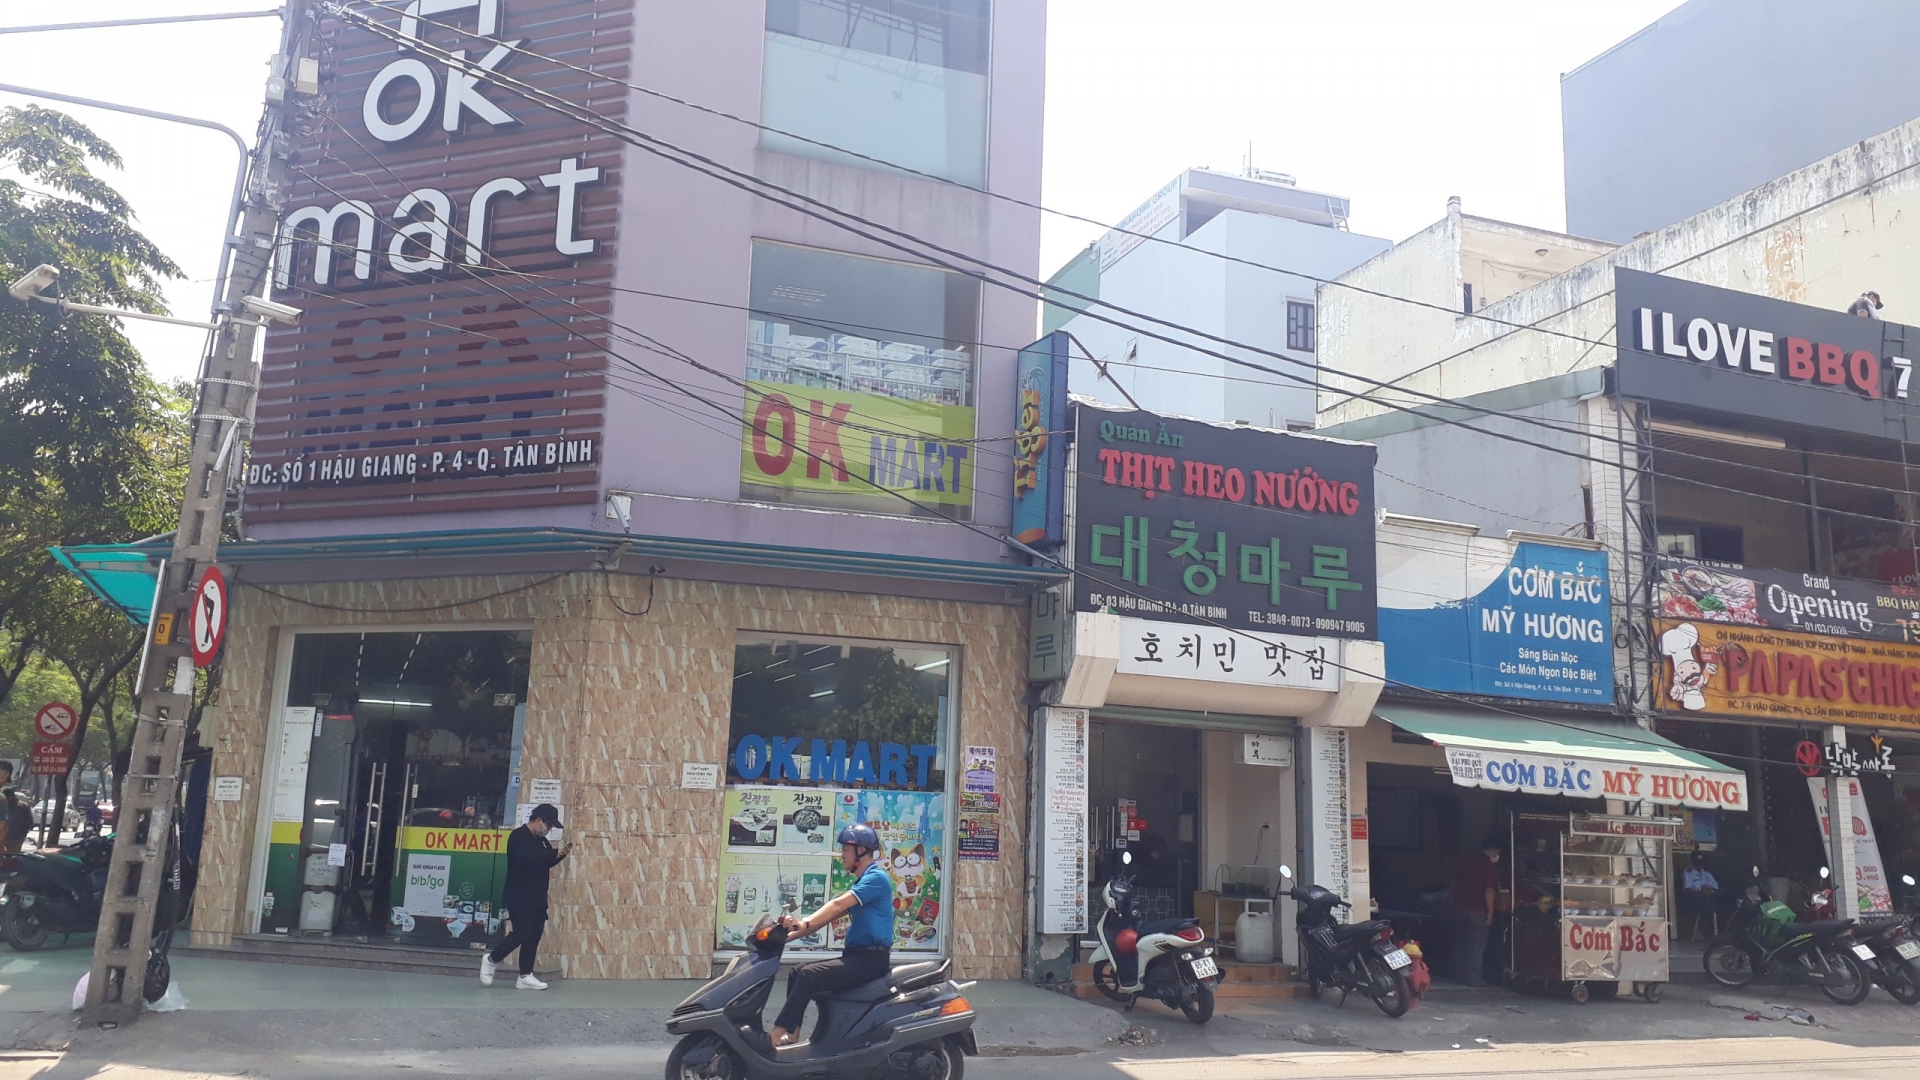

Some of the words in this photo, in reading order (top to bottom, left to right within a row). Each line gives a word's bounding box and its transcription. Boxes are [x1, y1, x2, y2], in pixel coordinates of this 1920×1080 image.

[363, 38, 530, 142] OK
[1152, 180, 1178, 204] GROUP
[275, 158, 600, 291] mart
[1640, 307, 1653, 351] I
[1661, 311, 1775, 374] LOVE
[1787, 336, 1882, 399] BBQ
[752, 392, 852, 483] OK
[868, 434, 968, 494] MART
[1013, 388, 1046, 500] Tiger
[1099, 418, 1151, 443] Quán
[1155, 421, 1185, 448] Ăn
[281, 453, 305, 483] SỐ
[321, 454, 356, 485] HẬU
[361, 453, 417, 478] GIANG
[504, 440, 538, 468] TÂN
[545, 437, 593, 464] BÌNH
[1100, 448, 1175, 499] THỊT
[1183, 460, 1246, 503] HEO
[1252, 466, 1360, 516] NƯỚNG
[1090, 515, 1363, 611] 대청마루
[1508, 564, 1555, 599] CƠM
[1560, 561, 1602, 604] BẮC
[1803, 573, 1830, 590] Grand
[1118, 594, 1136, 611] HẬU
[1137, 598, 1164, 613] GIANG
[1207, 604, 1228, 619] BÌNH
[1248, 610, 1265, 624] TEL:
[1767, 583, 1875, 633] Opening
[1876, 596, 1900, 610] BBQ
[1482, 604, 1516, 634] MỸ
[1524, 612, 1604, 643] HƯƠNG
[1134, 631, 1237, 673] 호치민
[1264, 641, 1328, 681] 맛집
[1518, 647, 1540, 663] Sáng
[1542, 649, 1559, 663] Bún
[1729, 632, 1755, 644] NHÁNH
[1756, 634, 1775, 645] CÔNG
[1776, 637, 1786, 646] TY
[1805, 640, 1818, 649] TOP
[1819, 641, 1837, 652] FOOD
[1500, 661, 1517, 674] Các
[1518, 662, 1537, 676] Món
[1539, 665, 1561, 680] Ngon
[1562, 665, 1580, 681] Đặc
[1580, 666, 1598, 683] Biệt
[1814, 705, 1827, 717] TÂN
[40, 744, 63, 754] CẤM
[735, 734, 804, 781] OK
[809, 738, 938, 788] MART
[793, 793, 823, 806] 진짜장
[1486, 759, 1536, 787] CƠM
[1543, 760, 1592, 791] BẮC
[1602, 766, 1643, 796] MỸ
[1650, 772, 1741, 805] HƯƠNG
[425, 831, 449, 849] OK
[453, 833, 503, 851] MART
[1569, 923, 1612, 952] Cơm
[1620, 920, 1660, 953] Bắc
